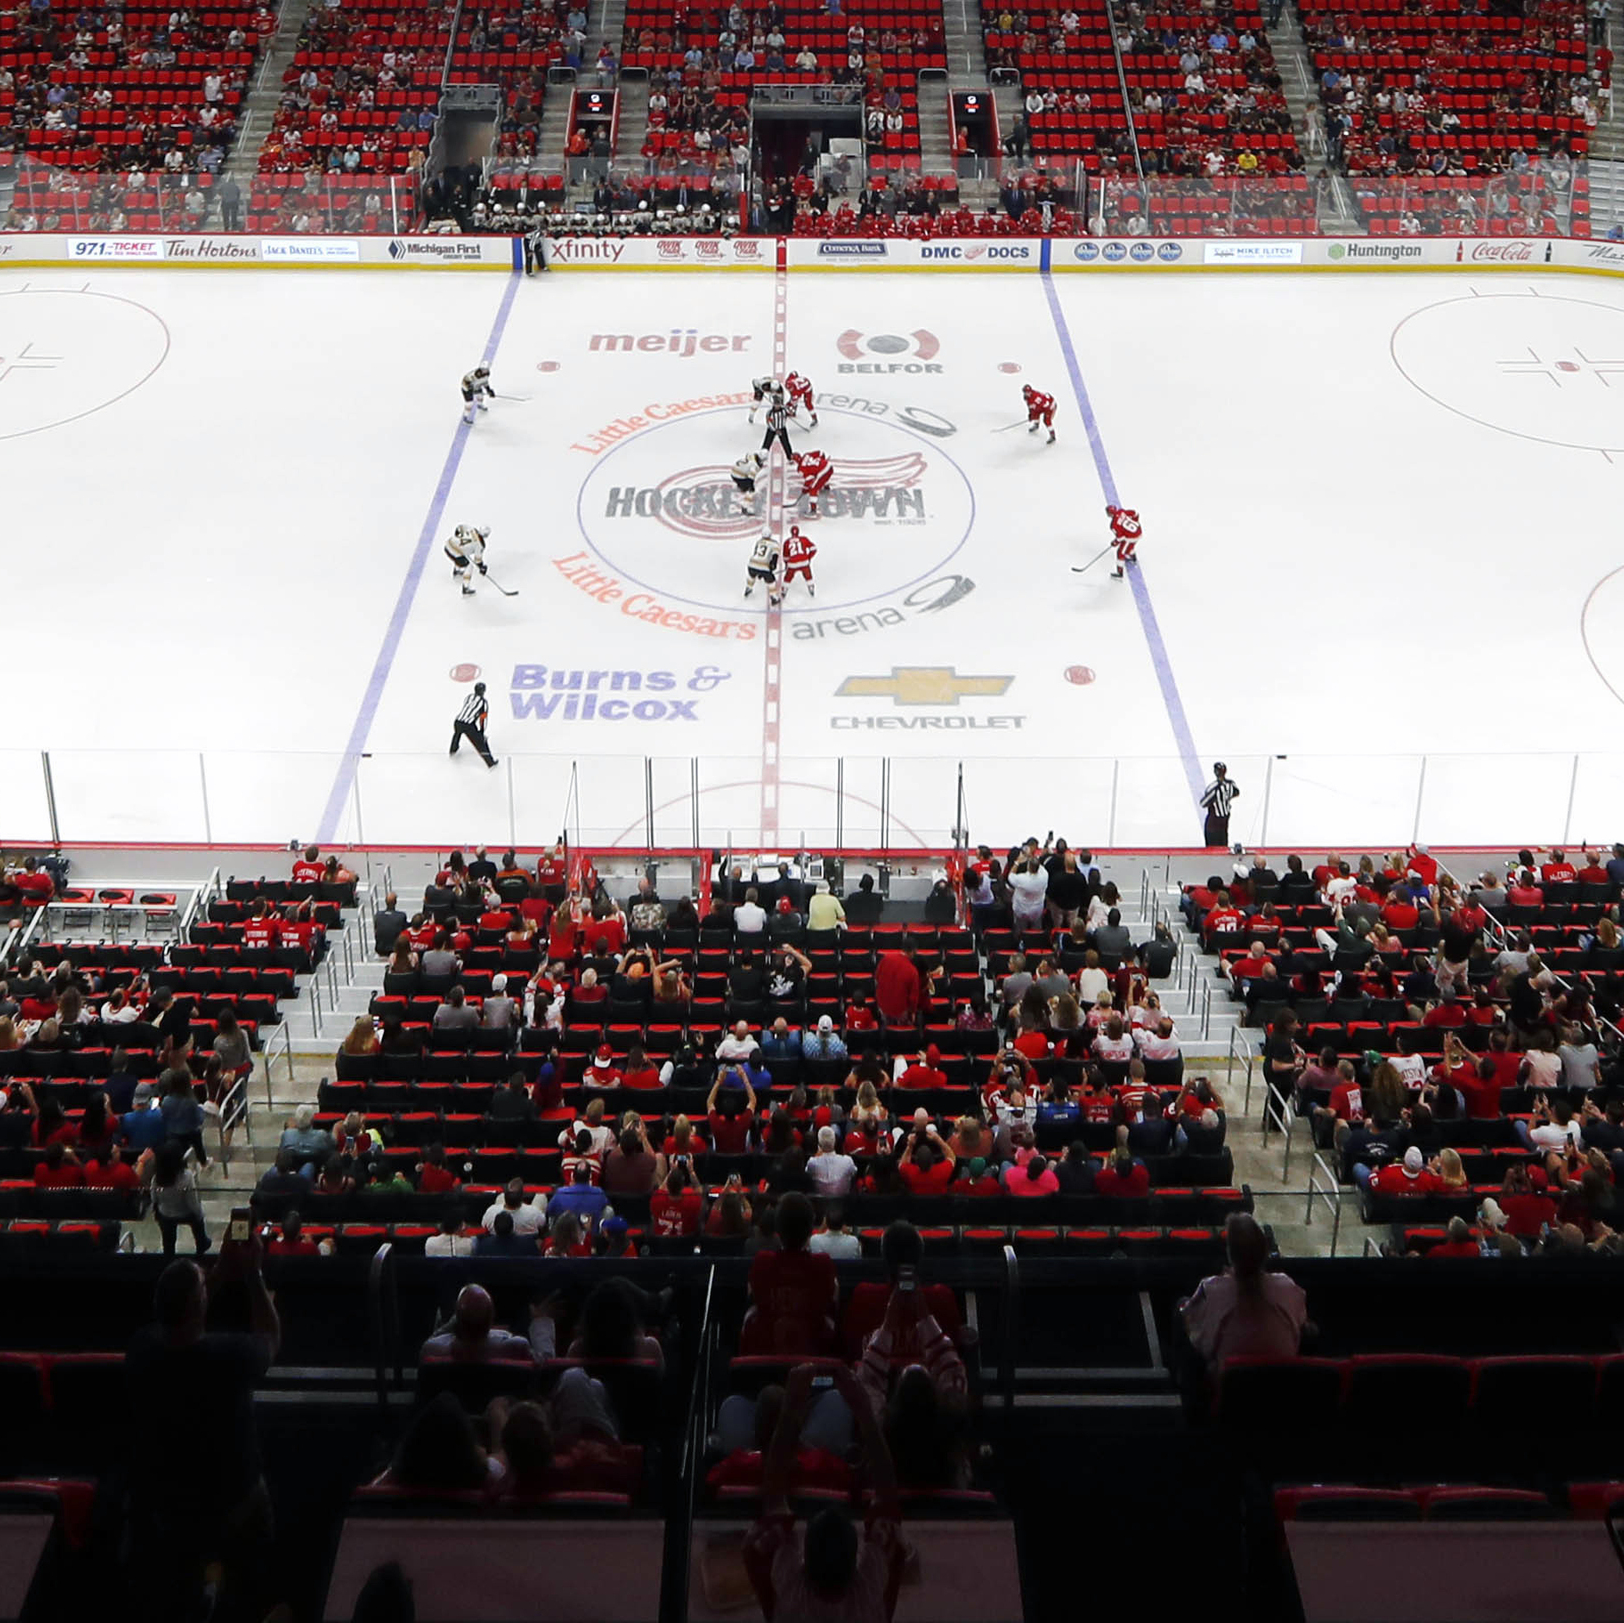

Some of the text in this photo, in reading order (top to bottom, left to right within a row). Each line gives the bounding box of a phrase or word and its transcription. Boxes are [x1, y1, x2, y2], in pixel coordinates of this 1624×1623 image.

[75, 242, 105, 256] 97.1
[113, 242, 155, 251] TICKET
[166, 240, 257, 257] Tim Hortons
[408, 243, 481, 255] Michigan First
[552, 239, 625, 262] xfinity
[921, 247, 1030, 259] DMC DOCS
[1348, 243, 1422, 260] Huntington
[588, 329, 752, 357] meijer
[837, 363, 944, 374] BELFOR
[570, 412, 650, 456] Little
[815, 392, 889, 415] rena
[789, 542, 804, 555] 21
[550, 549, 905, 642] Little Caesars arena
[510, 663, 732, 693] Burns &
[509, 692, 700, 722] Wilcox
[830, 715, 1028, 730] CHEVROLET
